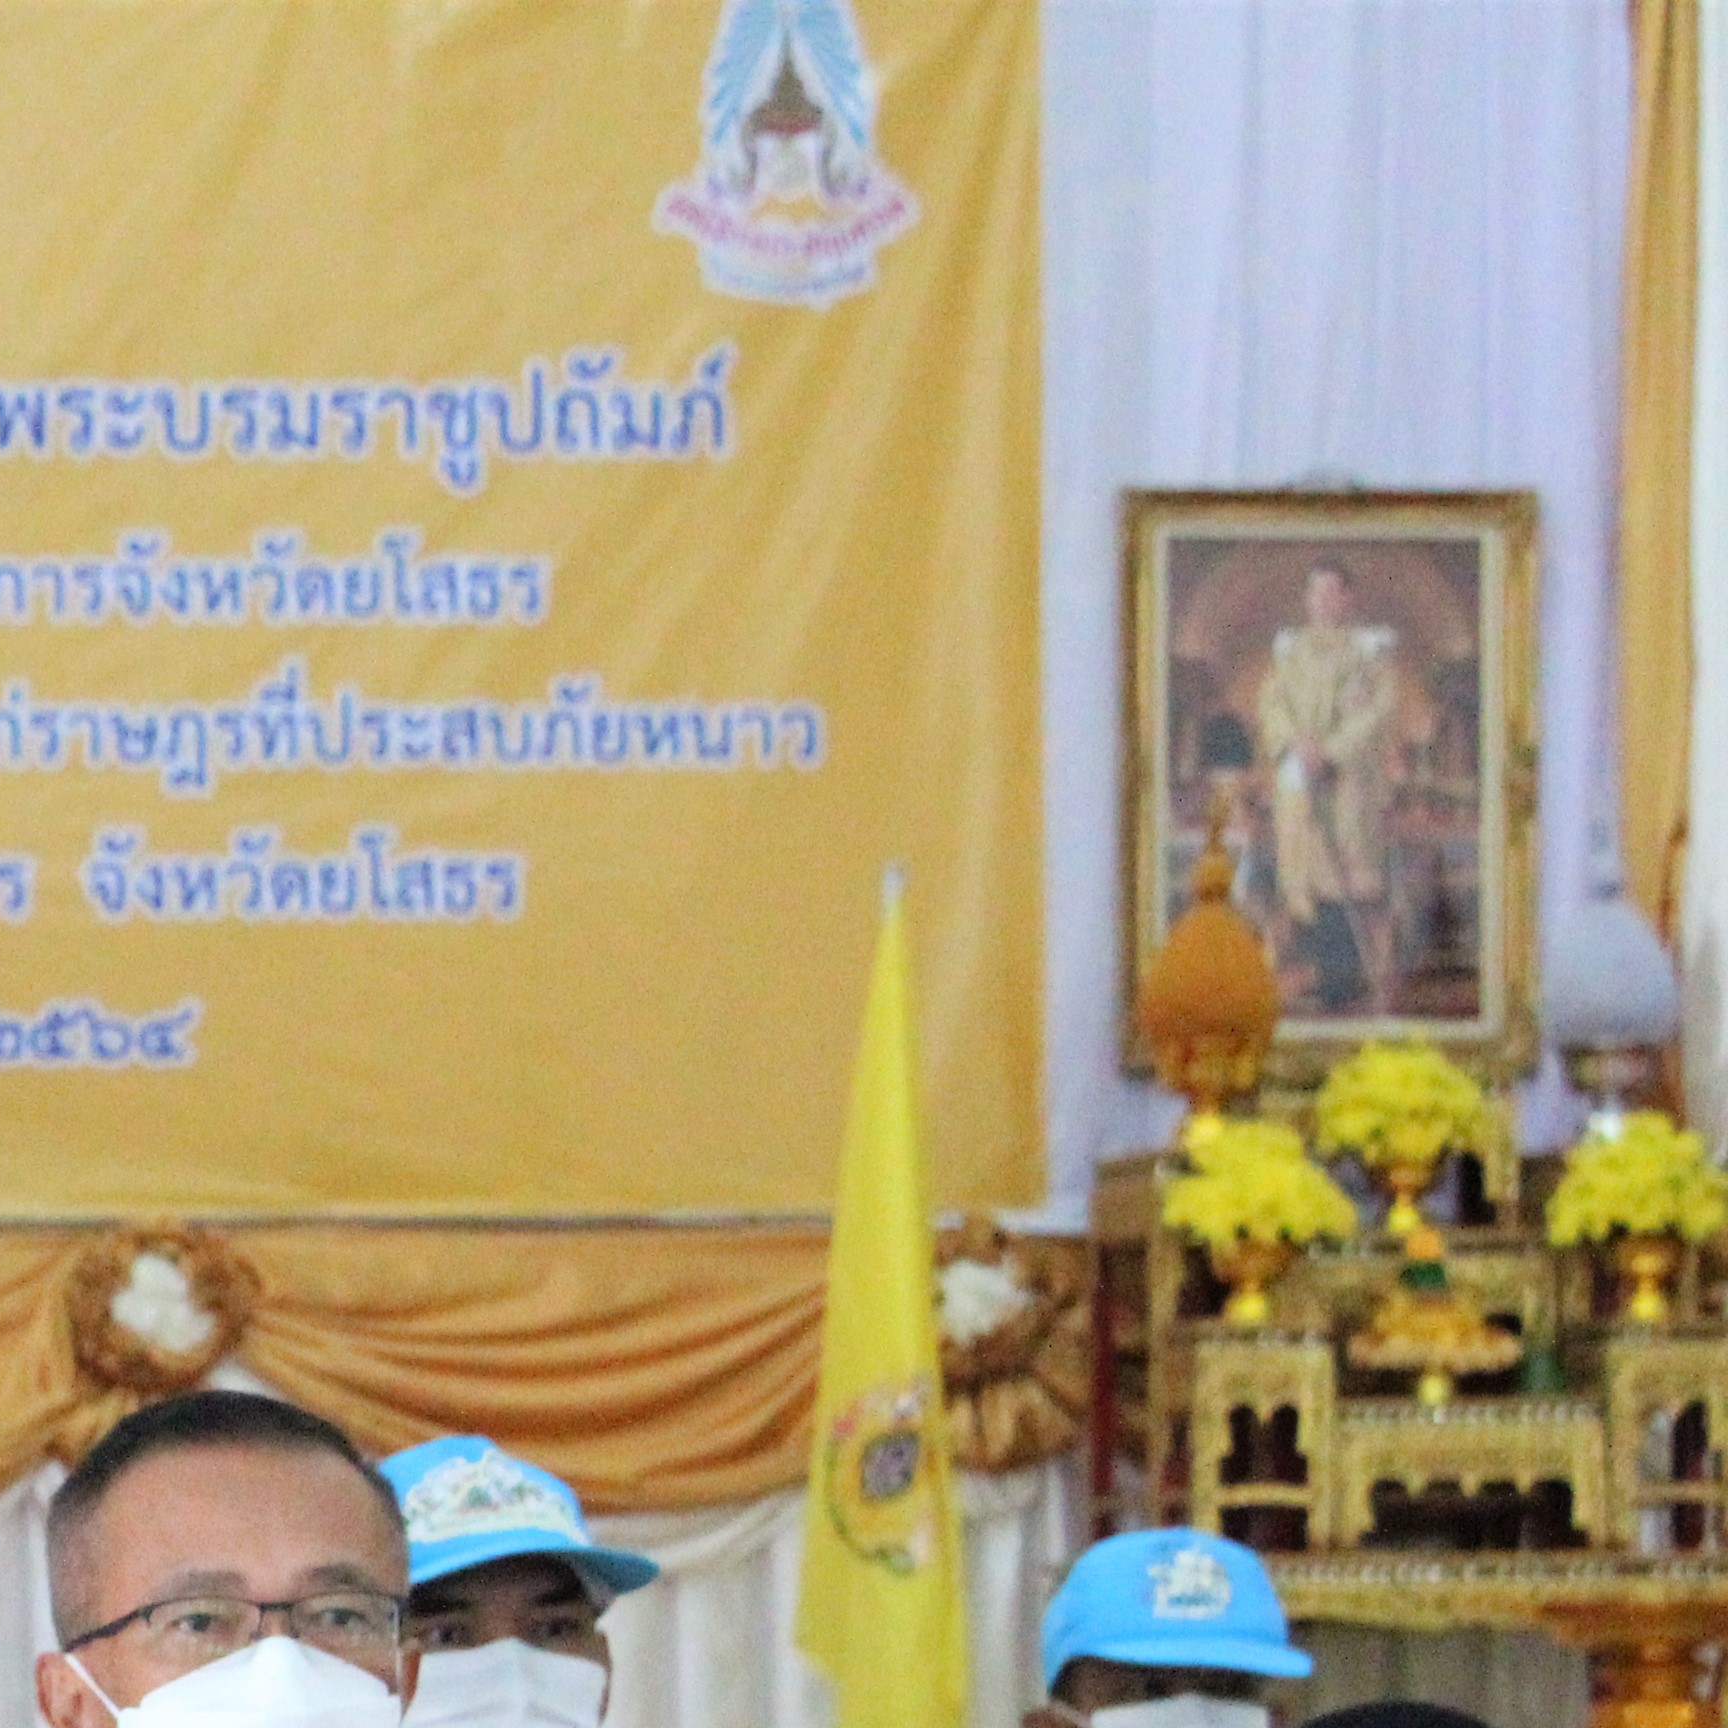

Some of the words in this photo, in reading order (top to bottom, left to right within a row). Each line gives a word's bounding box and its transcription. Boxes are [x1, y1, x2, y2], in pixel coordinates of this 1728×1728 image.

[85, 828, 520, 917] จังหวัดยโสธร
